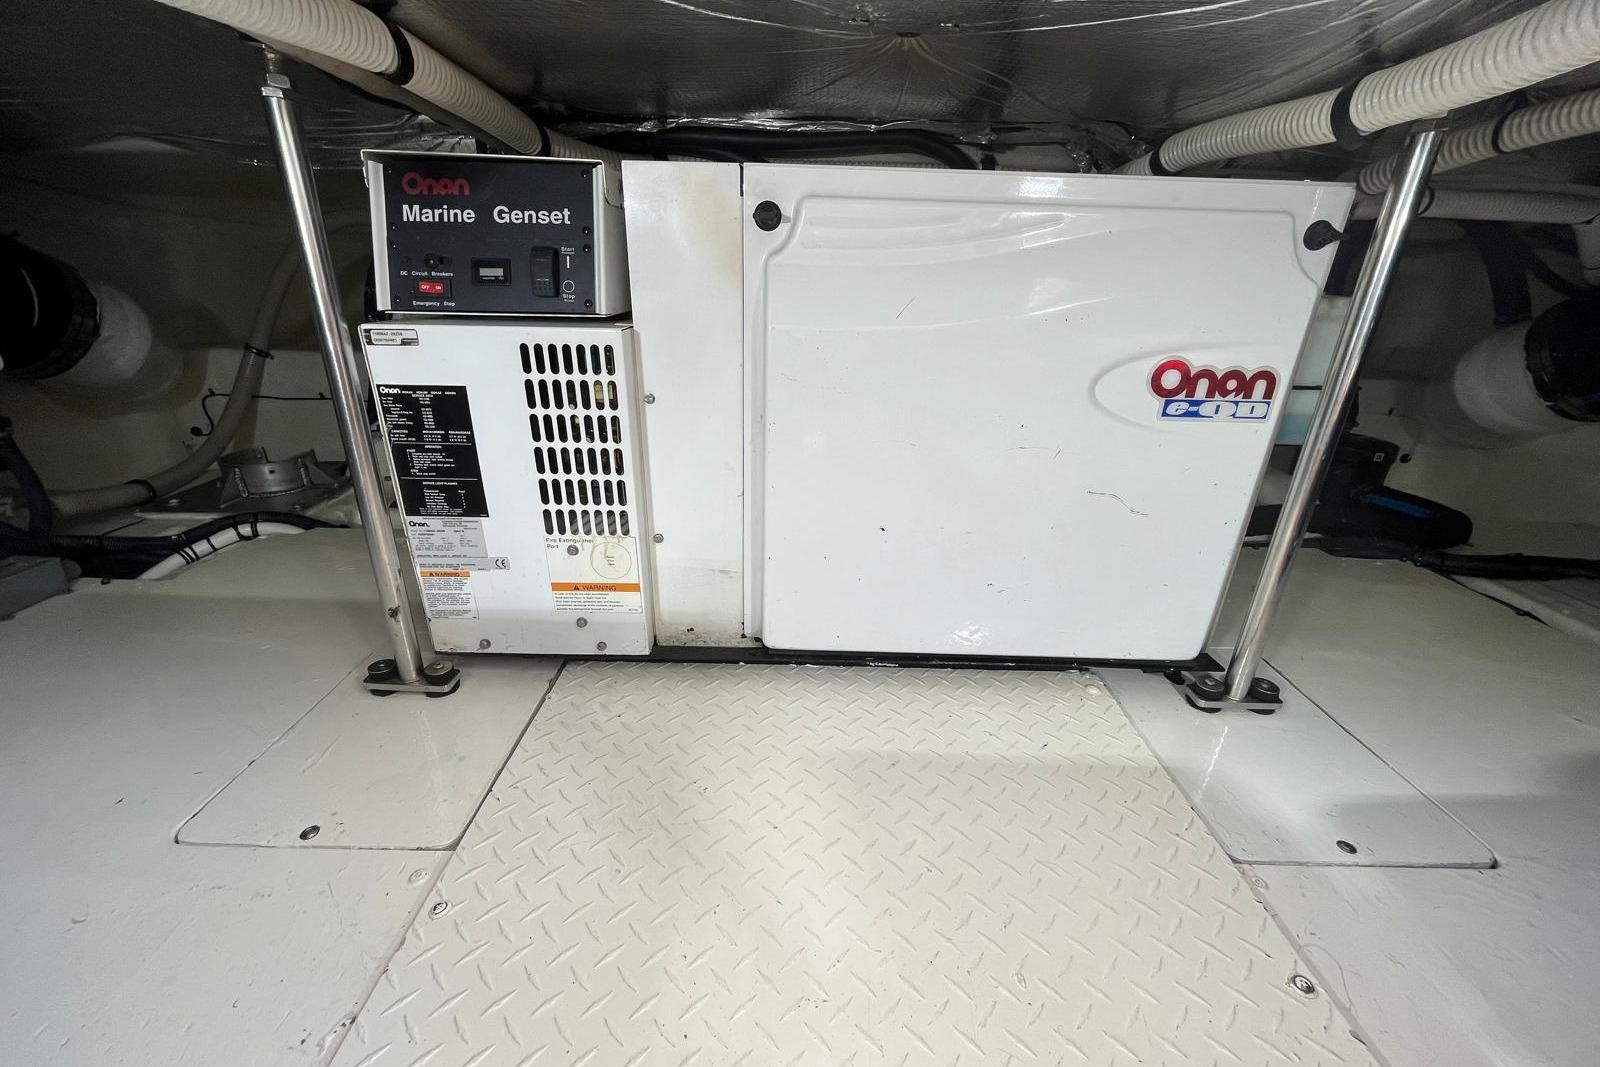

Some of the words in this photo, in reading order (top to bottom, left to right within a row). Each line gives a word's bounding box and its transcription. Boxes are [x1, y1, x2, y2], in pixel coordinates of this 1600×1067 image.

[401, 171, 470, 196] Onan
[402, 204, 476, 222] Marine
[493, 205, 571, 225] Genset
[1150, 359, 1277, 400] Onan
[379, 386, 401, 395] Onan
[582, 584, 617, 592] WARNING
